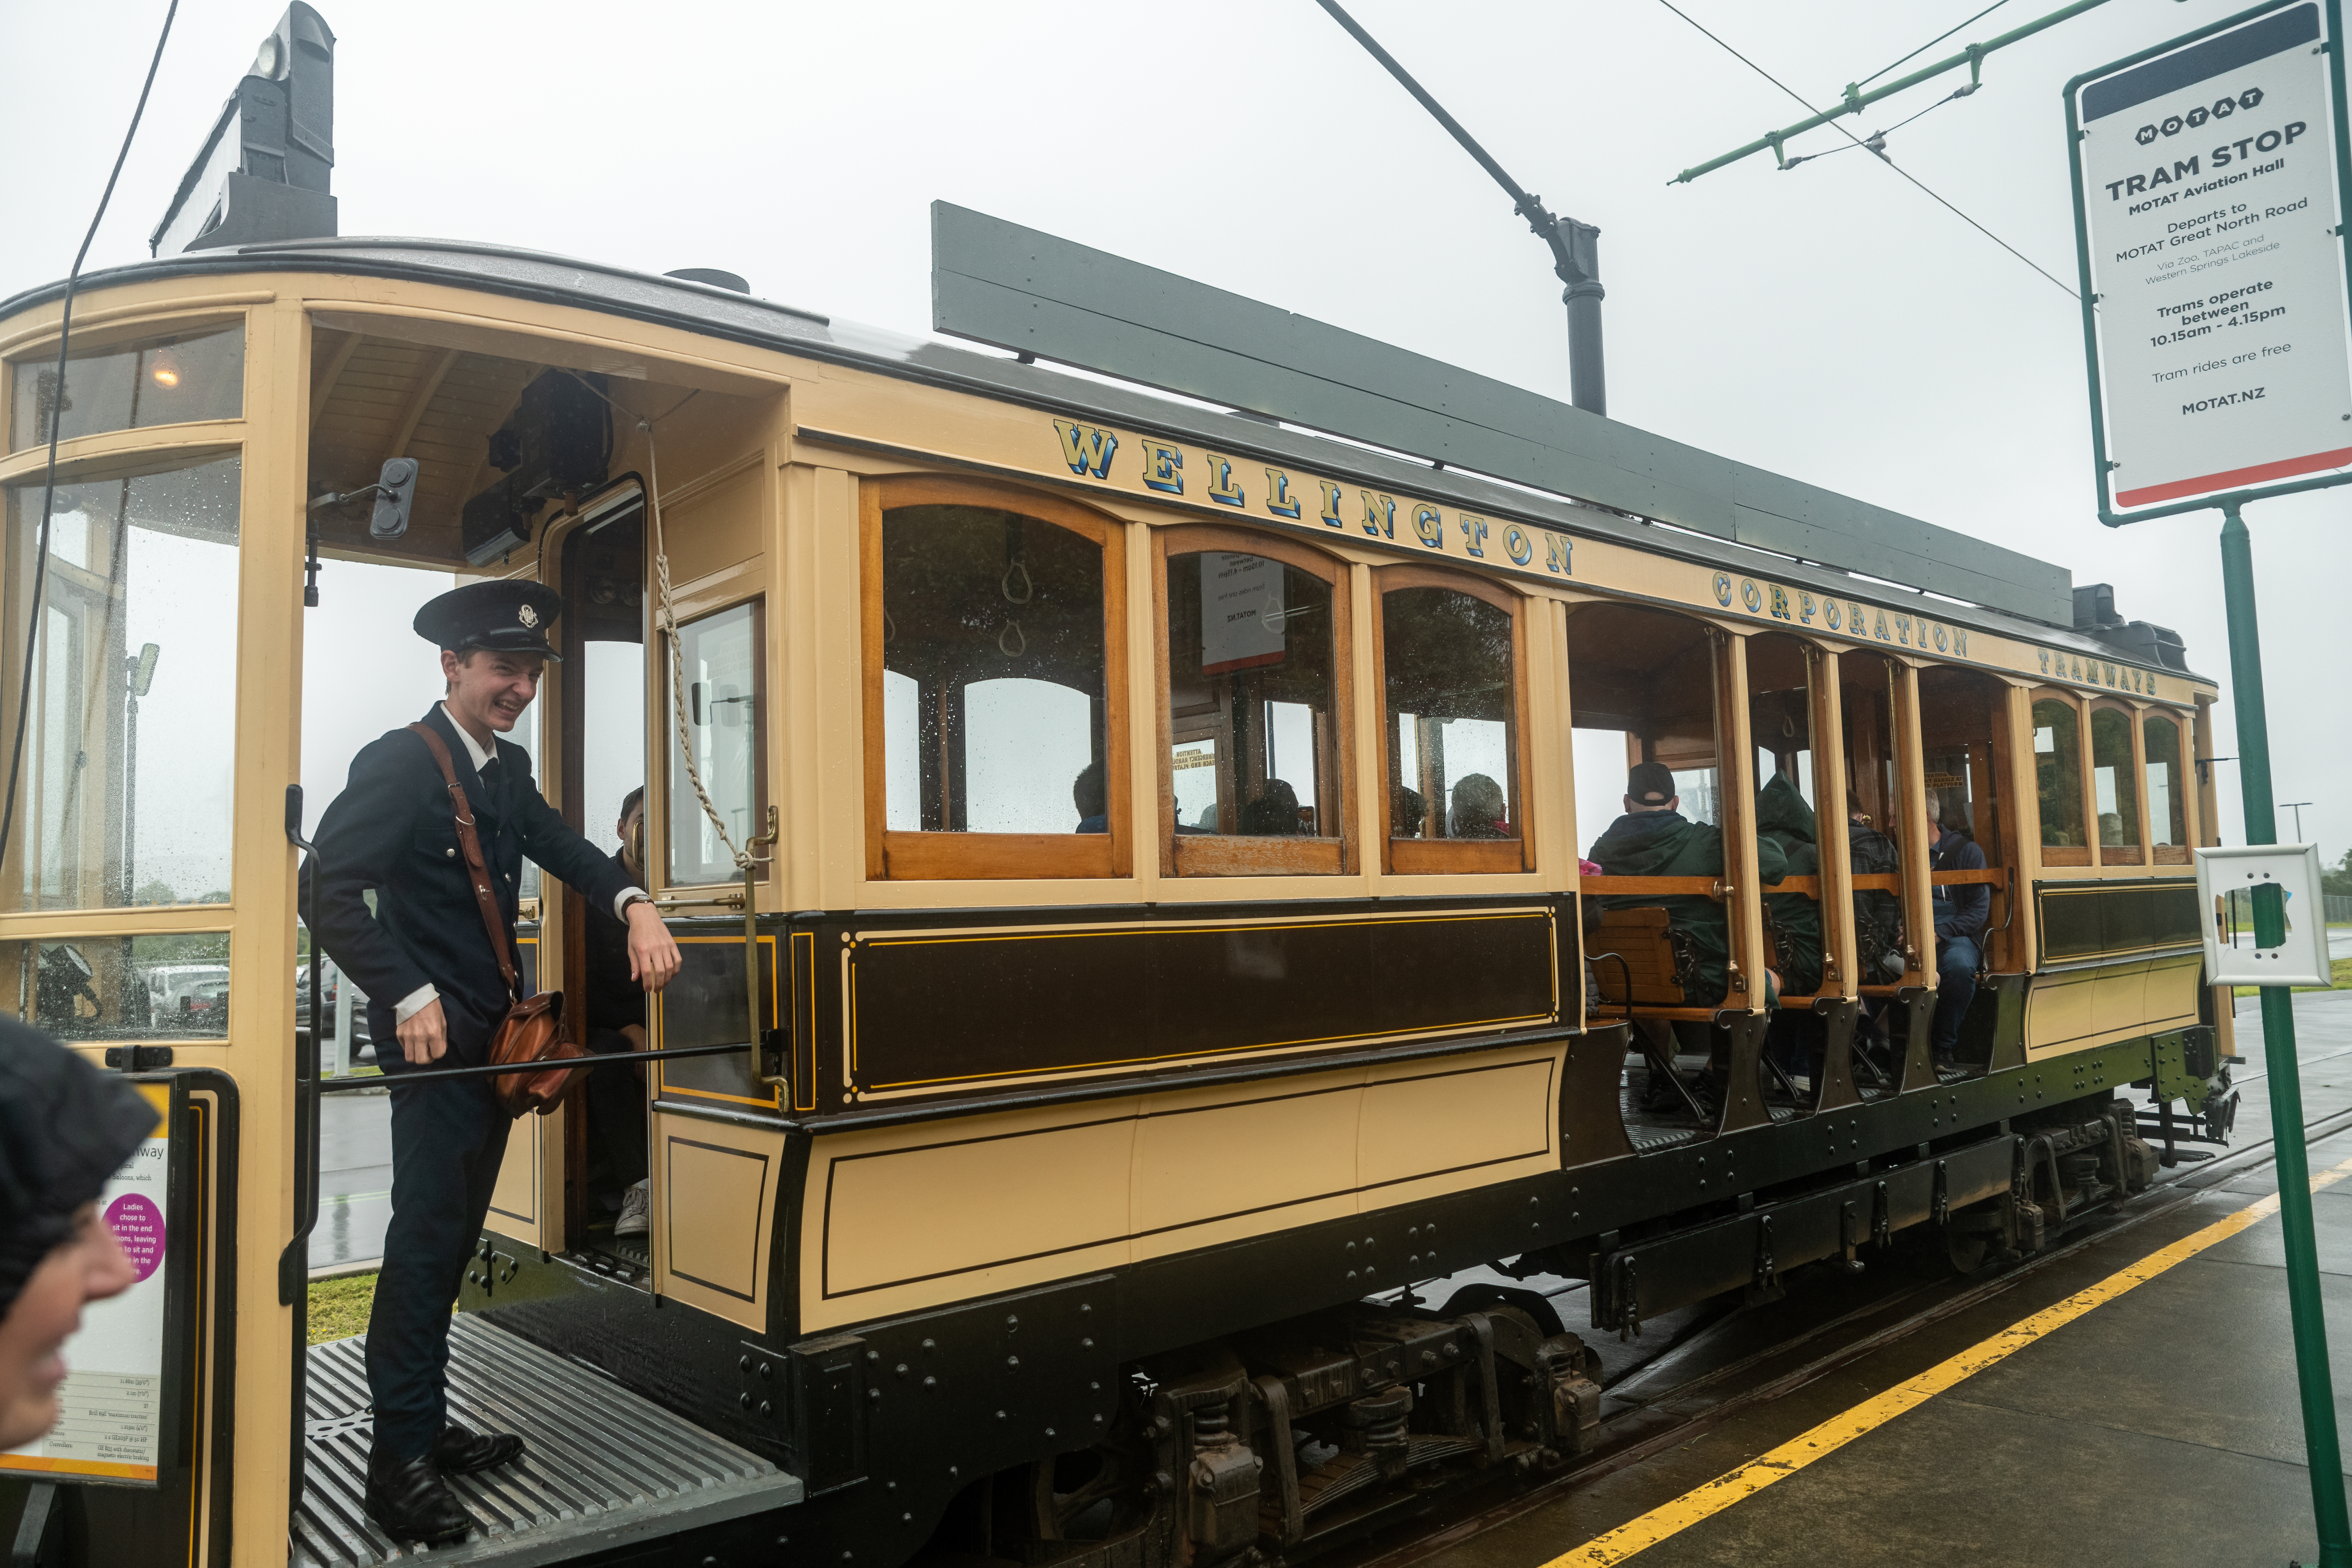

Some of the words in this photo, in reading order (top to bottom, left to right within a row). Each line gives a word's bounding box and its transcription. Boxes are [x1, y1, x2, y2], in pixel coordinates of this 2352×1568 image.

[2136, 88, 2263, 144] MOTAT
[2105, 156, 2200, 201] TRAM
[2211, 121, 2307, 168] STOP
[2129, 192, 2179, 216] MOTAT
[2184, 172, 2248, 199] Aviation
[2253, 158, 2284, 177] Hall
[2116, 240, 2165, 262] MOTAT
[2170, 227, 2211, 247] Great
[2216, 214, 2260, 234] North
[2265, 198, 2308, 219] Road
[2167, 208, 2227, 234] Departs
[2231, 202, 2247, 214] to
[2145, 268, 2187, 285] Western
[2190, 256, 2229, 274] Springs
[2232, 241, 2281, 261] Lakeside
[2158, 260, 2174, 270] Via
[2203, 241, 2239, 258] TAPAC
[2243, 234, 2264, 247] and
[2157, 298, 2204, 318] Trams
[2209, 280, 2273, 305] operate
[2181, 301, 2249, 326] between
[2151, 325, 2211, 347] 10.15am
[2228, 306, 2286, 328] 4.15pm
[2152, 368, 2188, 383] Tram
[2193, 358, 2227, 374] rides
[2232, 351, 2257, 364] are
[2261, 343, 2292, 357] free
[2182, 387, 2265, 415] MOTAT.NZ
[1053, 419, 1572, 575] WELLINGTON
[1712, 571, 1967, 657] CORPORATION
[2038, 648, 2156, 696] TRAMWAYS
[134, 1235, 156, 1243] leaving
